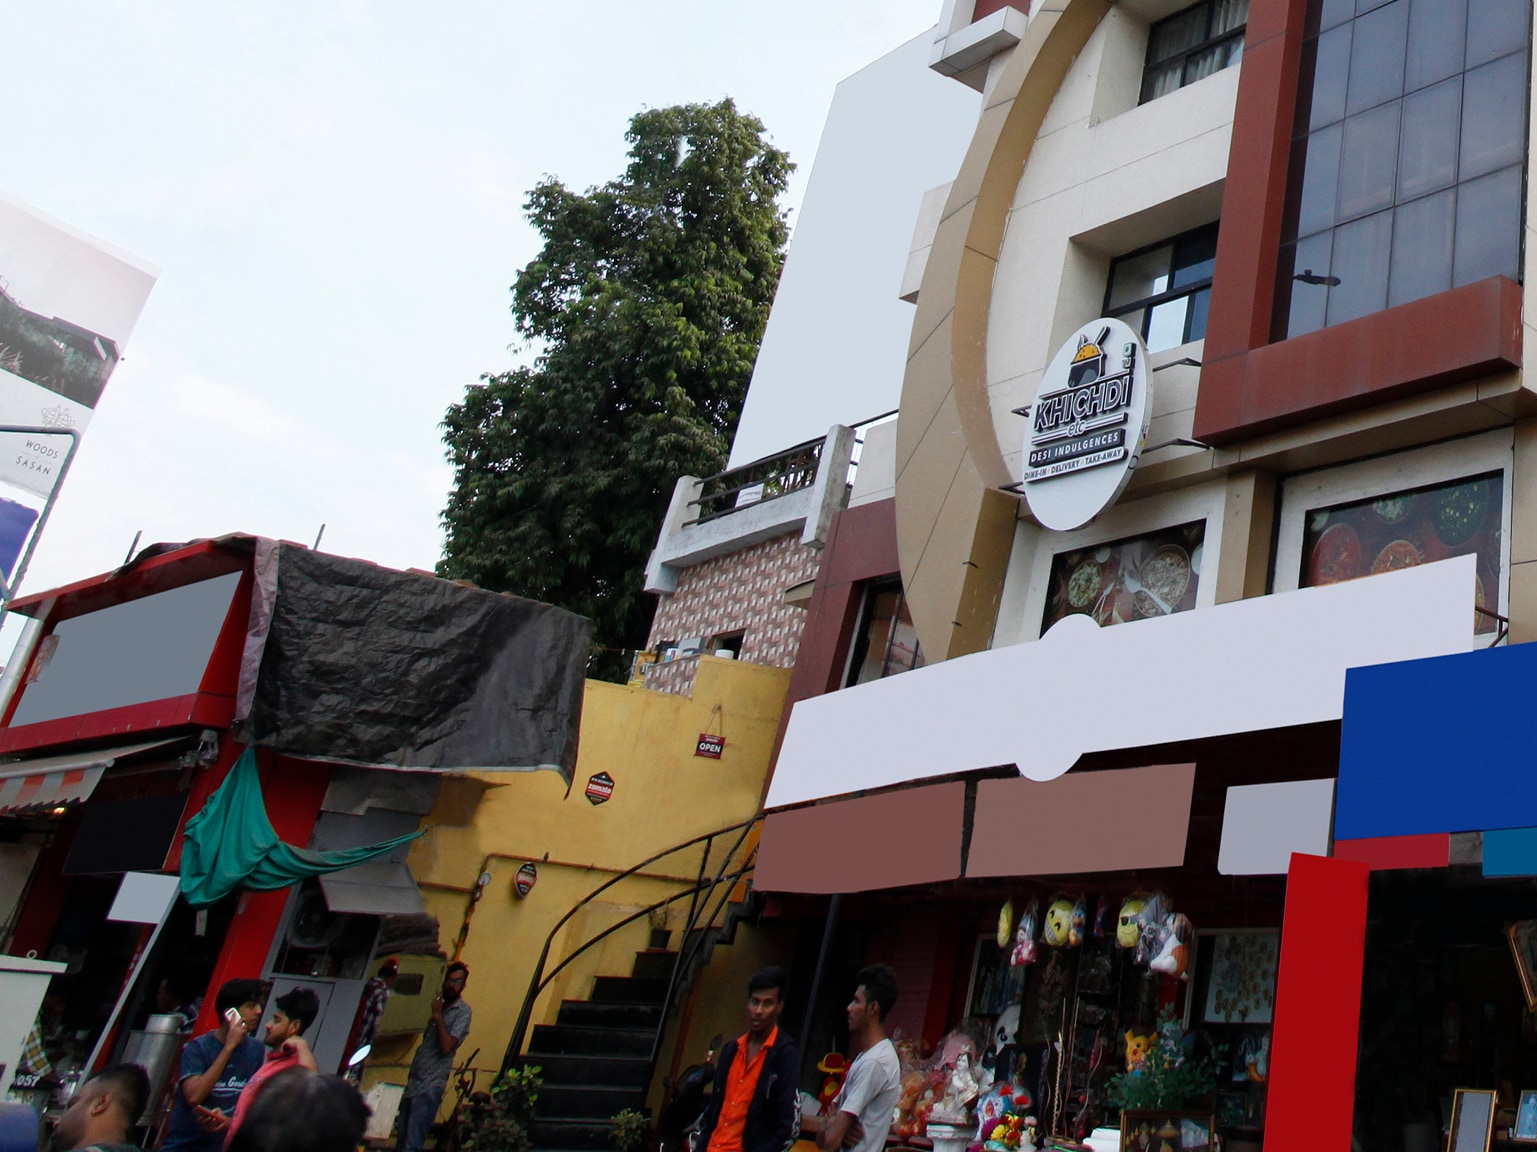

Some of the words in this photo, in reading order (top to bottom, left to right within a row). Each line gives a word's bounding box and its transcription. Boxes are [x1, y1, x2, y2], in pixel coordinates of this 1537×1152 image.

[1034, 375, 1130, 431] KHICHDI
[1067, 419, 1087, 437] etc
[26, 439, 59, 459] WOODS
[1031, 451, 1051, 463] DESI
[1054, 432, 1118, 457] INDULGENCES
[16, 456, 51, 475] SASAN
[1024, 469, 1047, 480] DINE-IN
[1051, 460, 1080, 474] DELIVERY
[1085, 449, 1122, 465] TAKE-AWAY
[699, 742, 721, 753] OPEN
